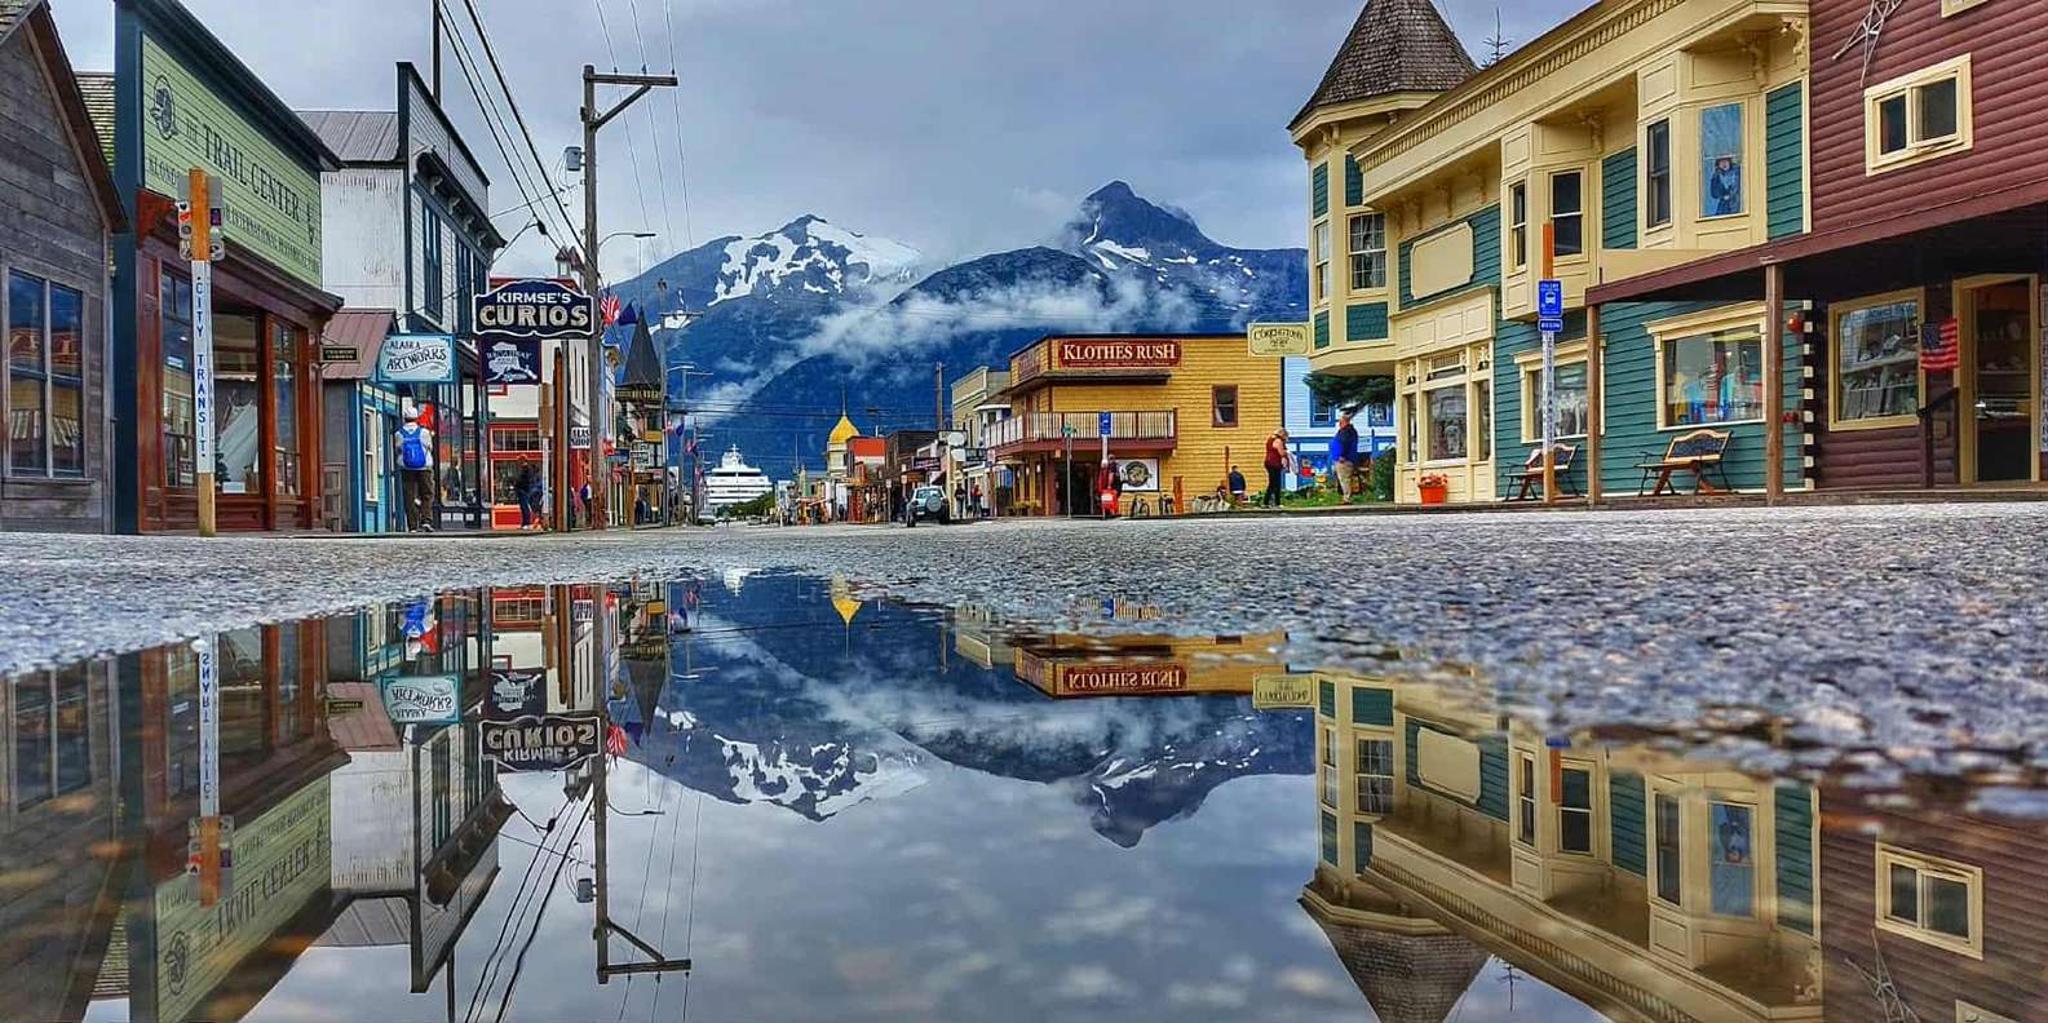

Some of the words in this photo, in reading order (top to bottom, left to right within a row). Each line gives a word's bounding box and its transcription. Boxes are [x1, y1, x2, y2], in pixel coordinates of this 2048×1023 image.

[203, 124, 248, 187] TRAIL
[251, 163, 301, 223] CENTER
[195, 282, 205, 338] CITY
[496, 292, 572, 304] KIRMSE'S
[480, 305, 589, 326] CURIOS
[386, 347, 448, 371] ARTWORKS
[1063, 344, 1133, 360] KLOTHES
[1136, 344, 1178, 360] RUSH
[196, 354, 206, 453] TRANSIT
